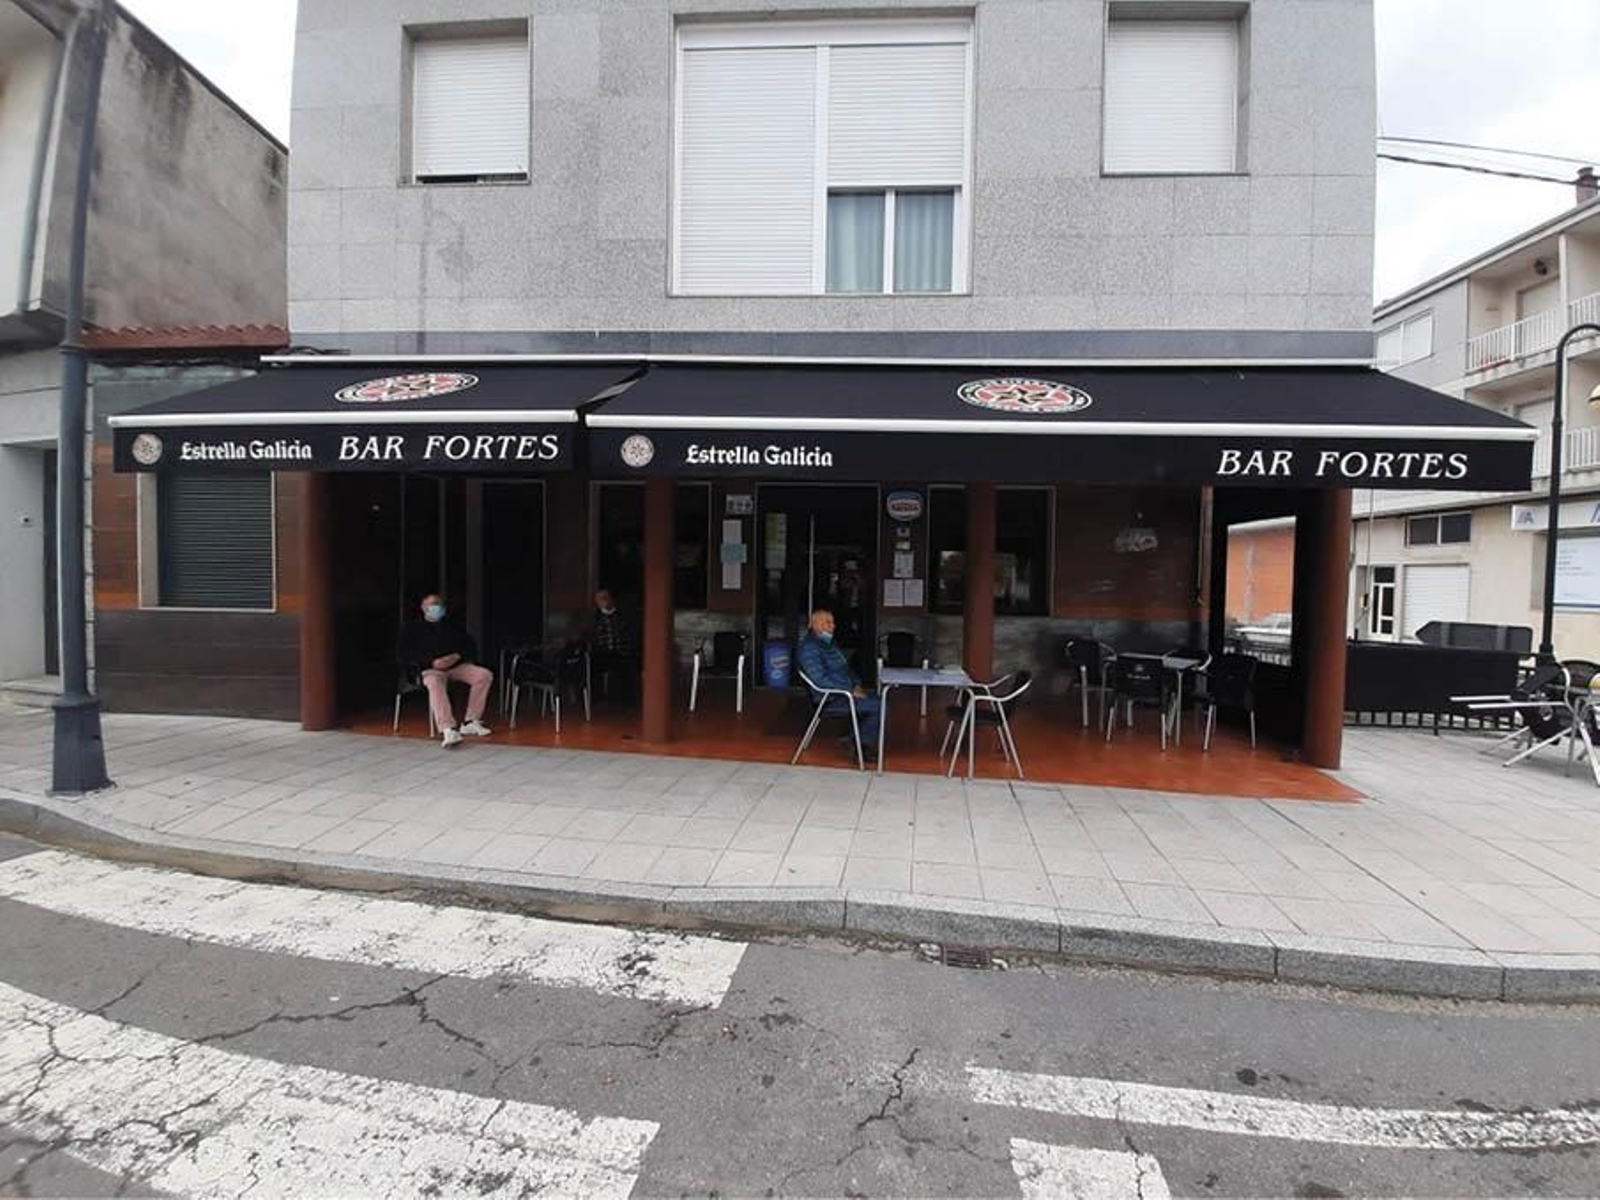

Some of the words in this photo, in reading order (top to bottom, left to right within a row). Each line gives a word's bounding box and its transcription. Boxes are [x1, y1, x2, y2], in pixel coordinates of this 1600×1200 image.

[179, 440, 247, 462] Estrella
[248, 439, 313, 461] Galicia
[338, 435, 404, 461] BAR
[423, 434, 560, 461] FORTES
[685, 443, 760, 466] Estrella
[763, 444, 834, 468] Galicia
[1216, 449, 1293, 477] BAR
[1315, 451, 1468, 480] FORTES
